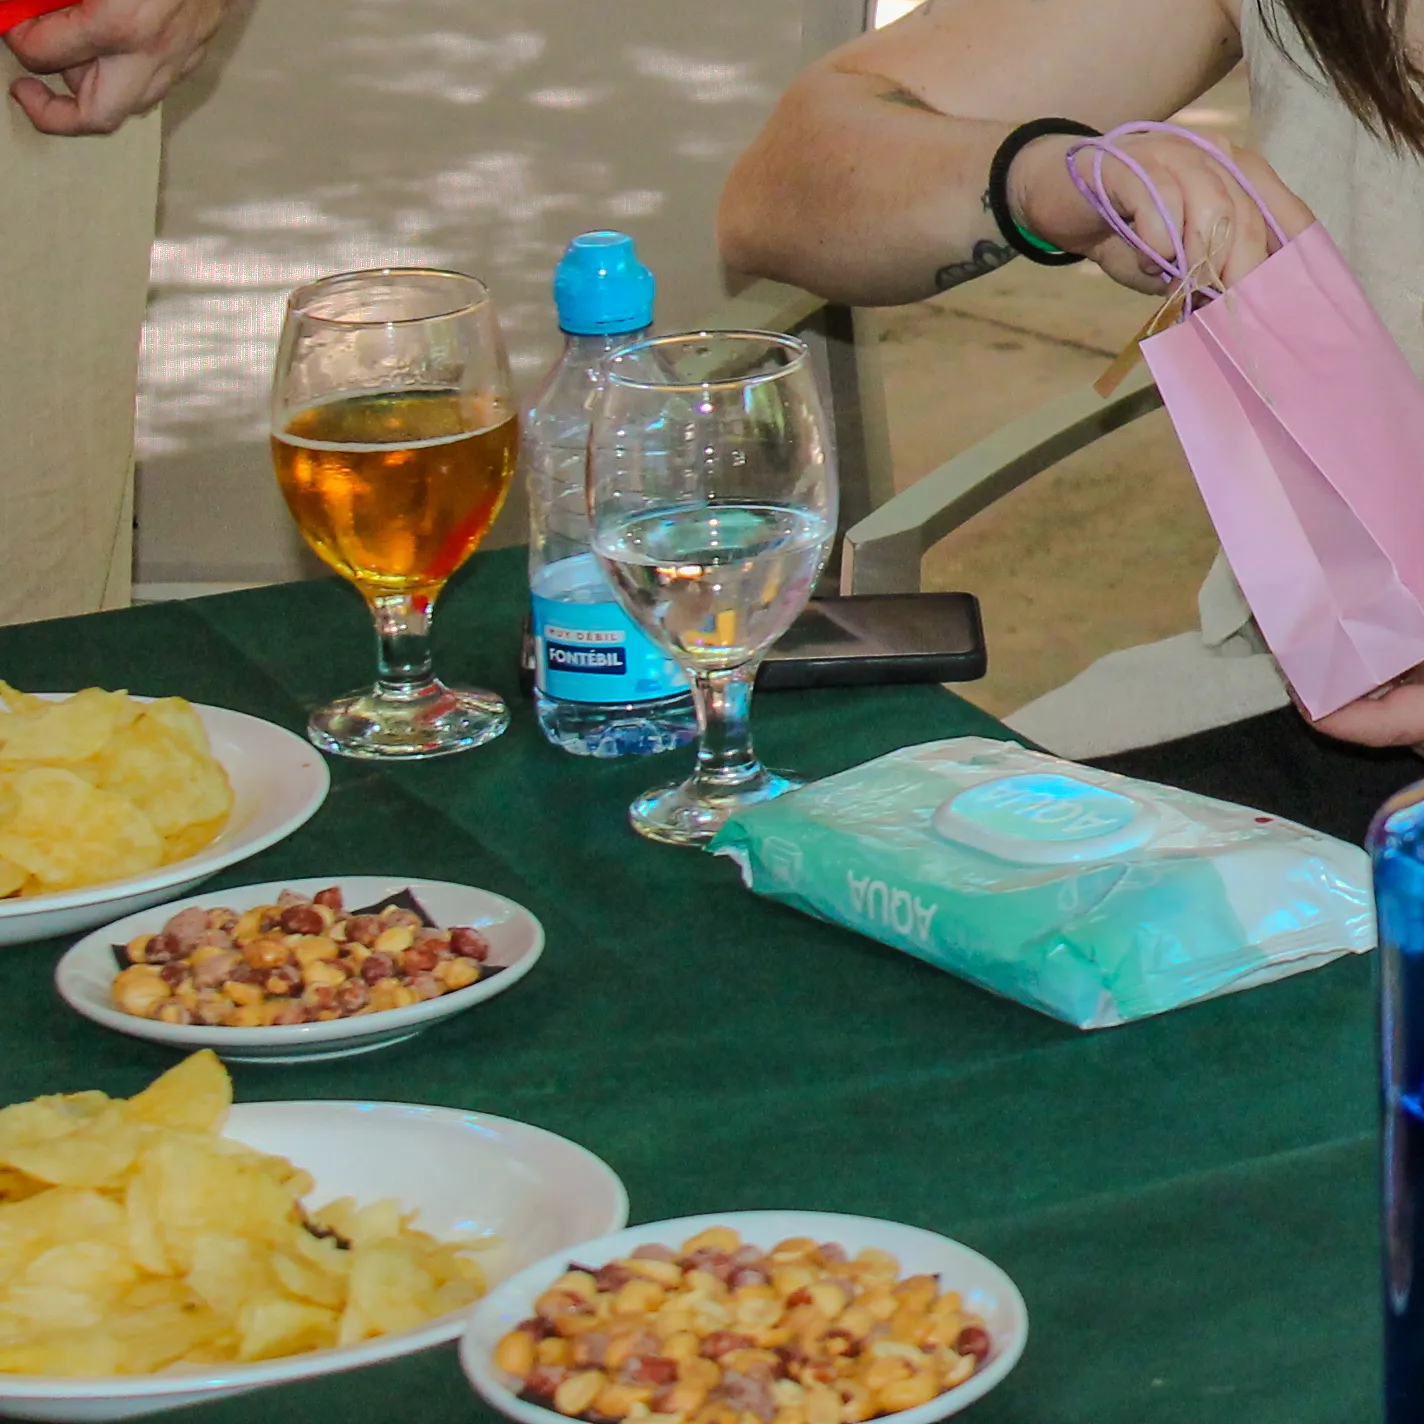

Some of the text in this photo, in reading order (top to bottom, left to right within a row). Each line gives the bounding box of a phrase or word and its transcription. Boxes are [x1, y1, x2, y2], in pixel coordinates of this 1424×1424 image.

[549, 647, 623, 667] FONTÉBIL
[979, 779, 1118, 834] AQUA
[846, 868, 938, 941] AQUA
